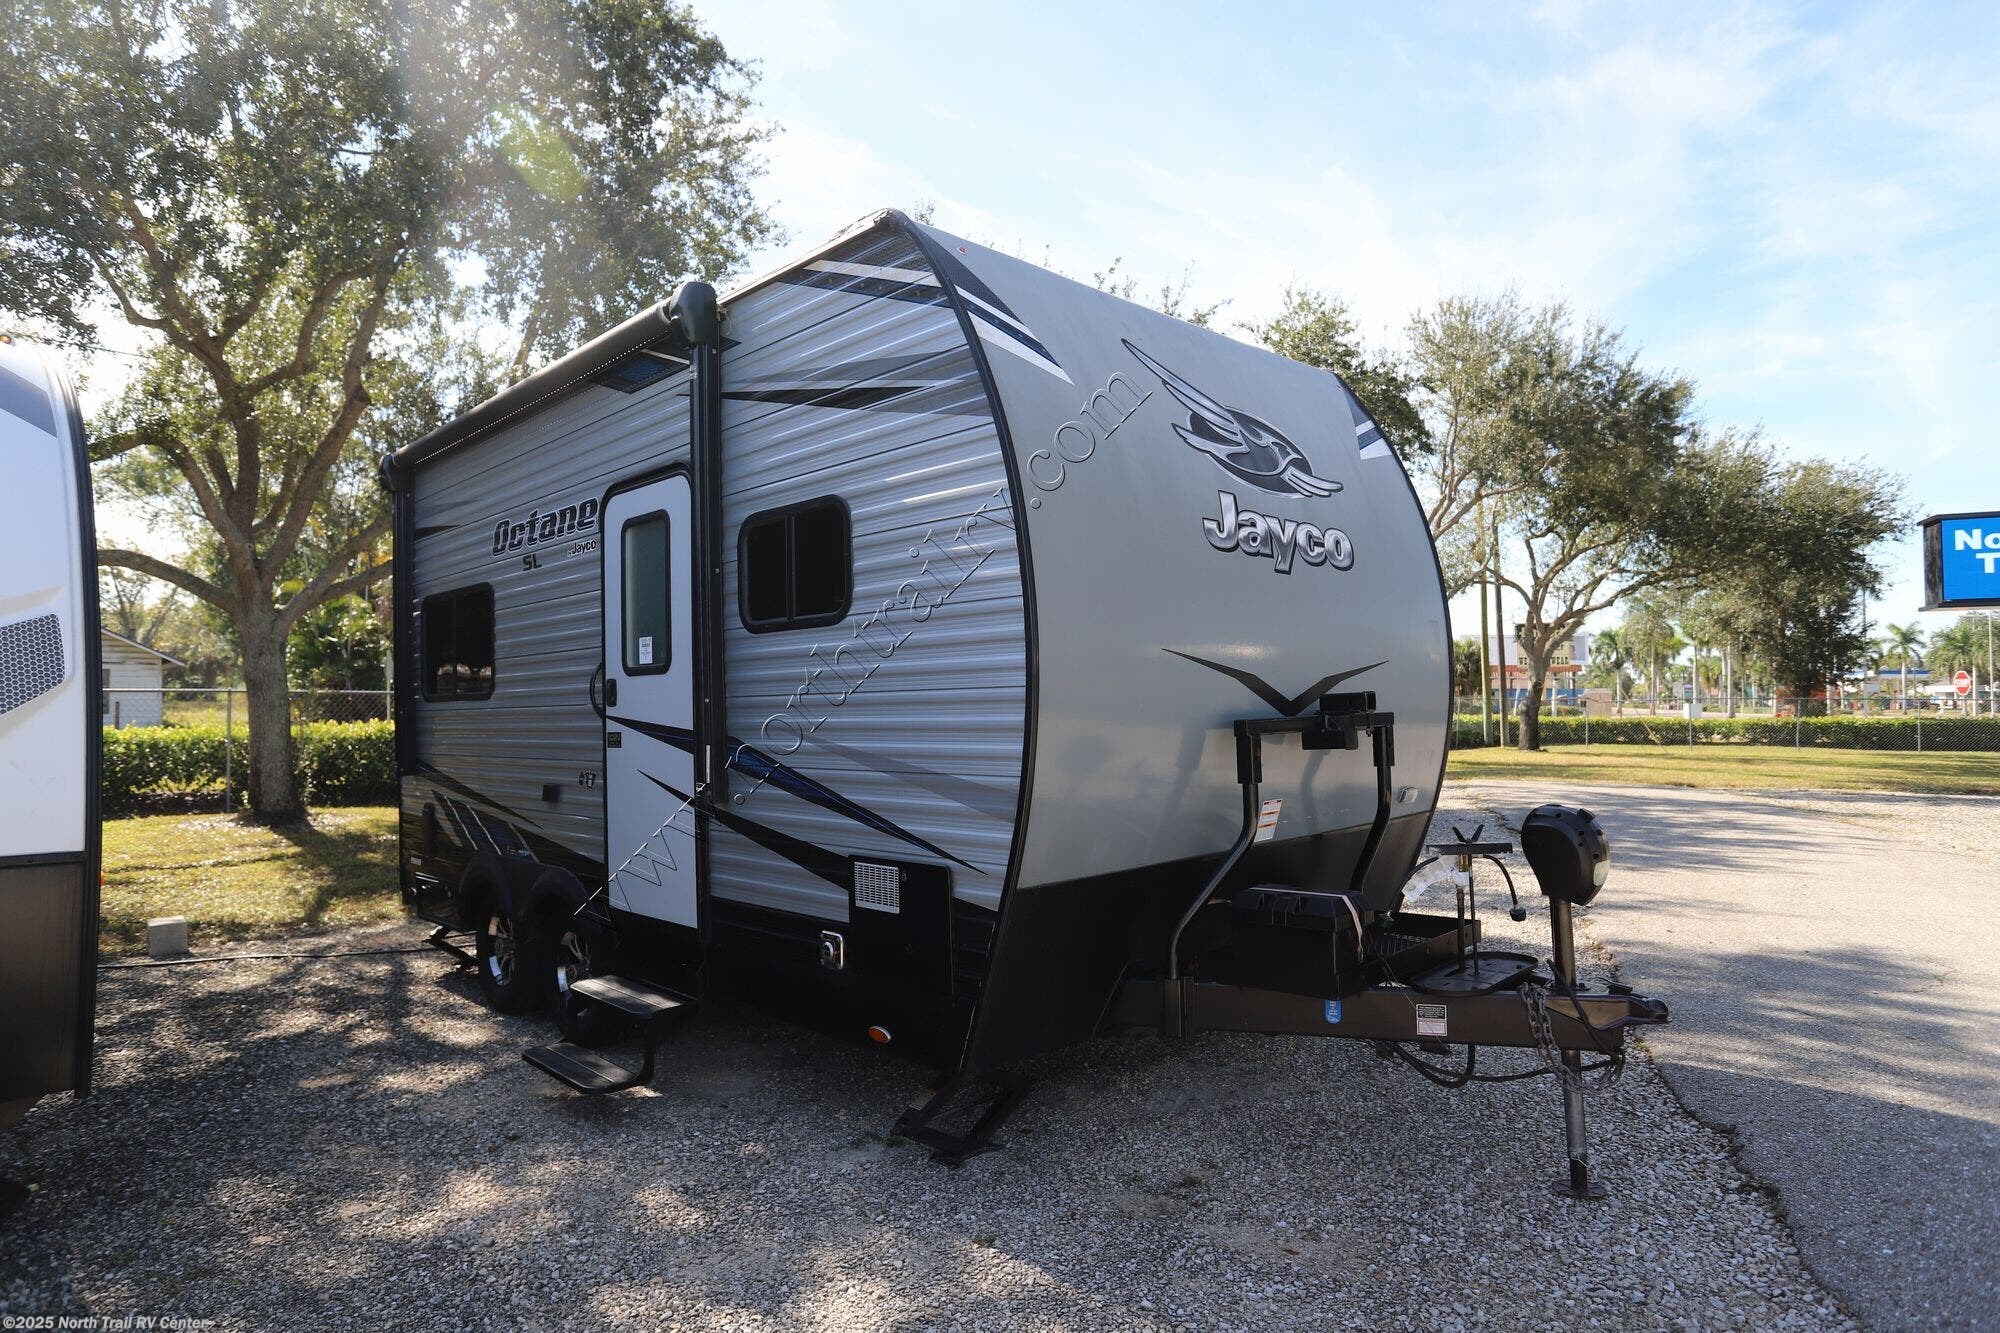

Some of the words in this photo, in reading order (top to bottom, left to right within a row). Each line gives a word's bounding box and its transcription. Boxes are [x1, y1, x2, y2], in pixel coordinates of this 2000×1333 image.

[493, 497, 599, 556] Octane
[1202, 490, 1354, 575] Jayco
[523, 554, 542, 571] SL
[571, 540, 597, 555] Jayco
